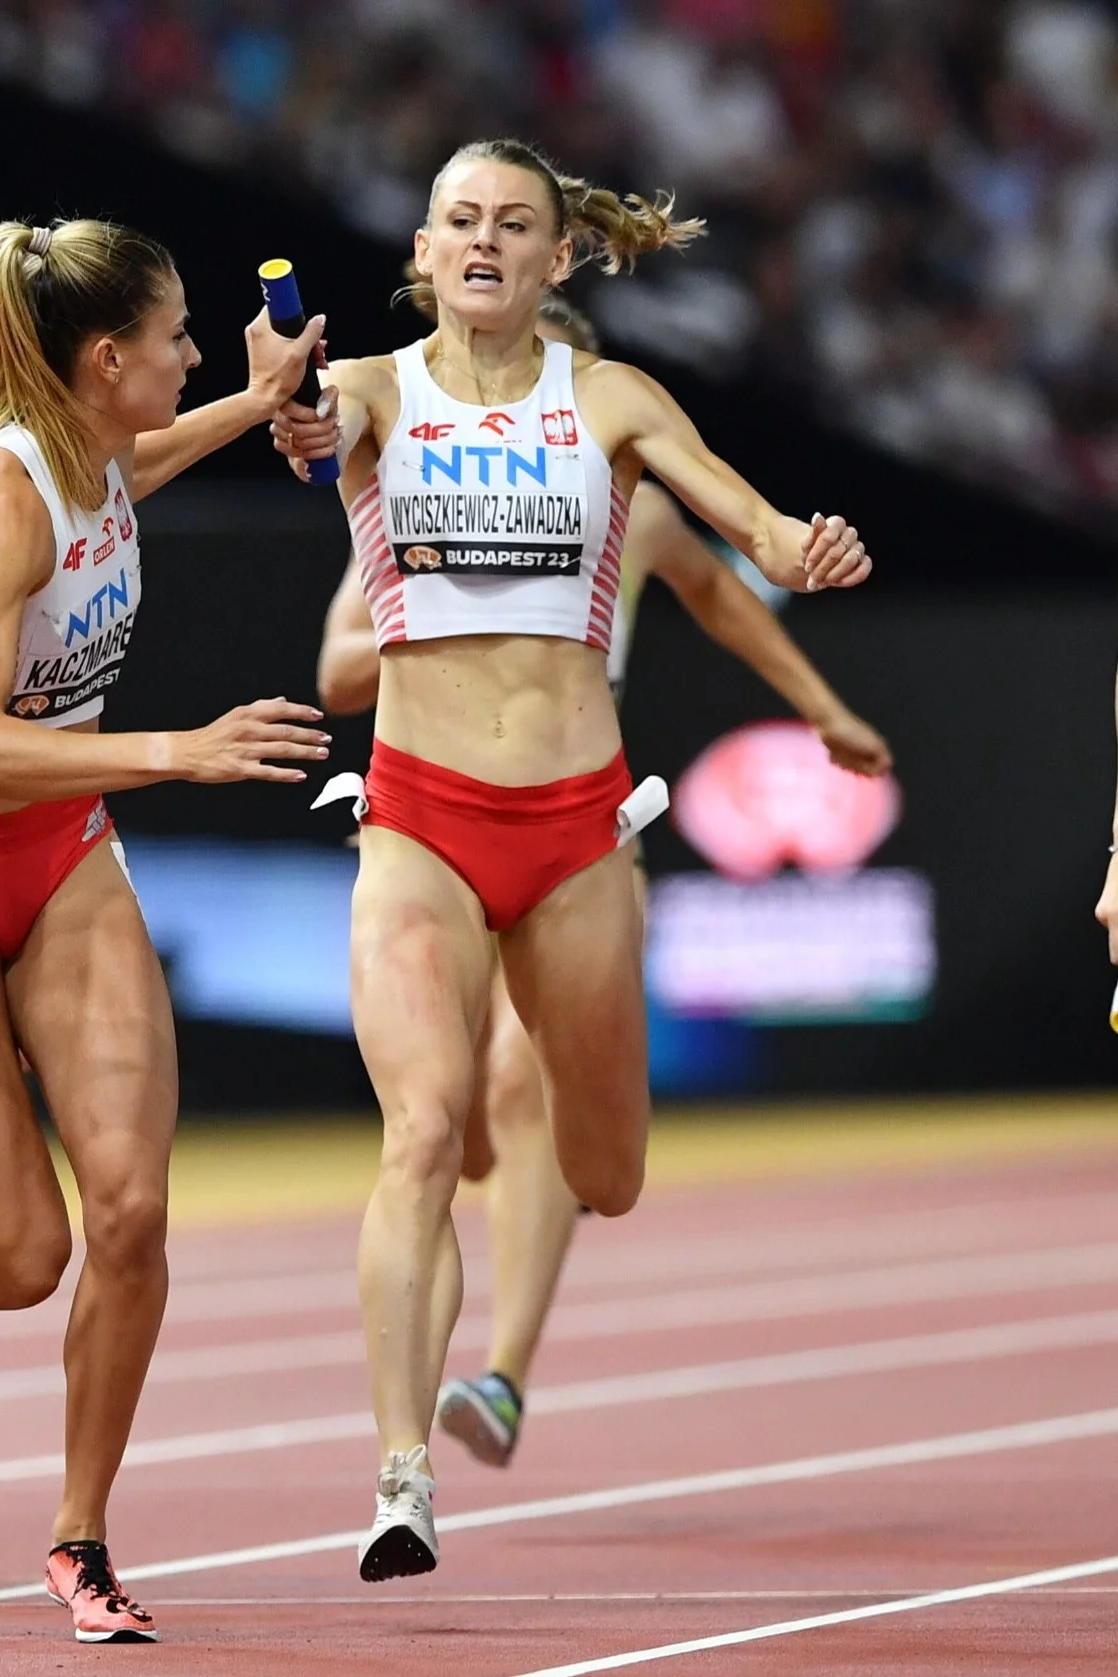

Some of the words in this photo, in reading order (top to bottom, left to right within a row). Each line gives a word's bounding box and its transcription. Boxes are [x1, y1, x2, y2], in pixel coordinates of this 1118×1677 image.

[422, 445, 546, 487] NTN
[389, 494, 581, 536] WYCISZKIEWICZ-ZAWADZKA
[94, 540, 114, 563] ORLEN
[446, 549, 545, 567] BUDAPEST
[65, 567, 128, 648] NTN
[54, 667, 121, 708] BUDAPEST
